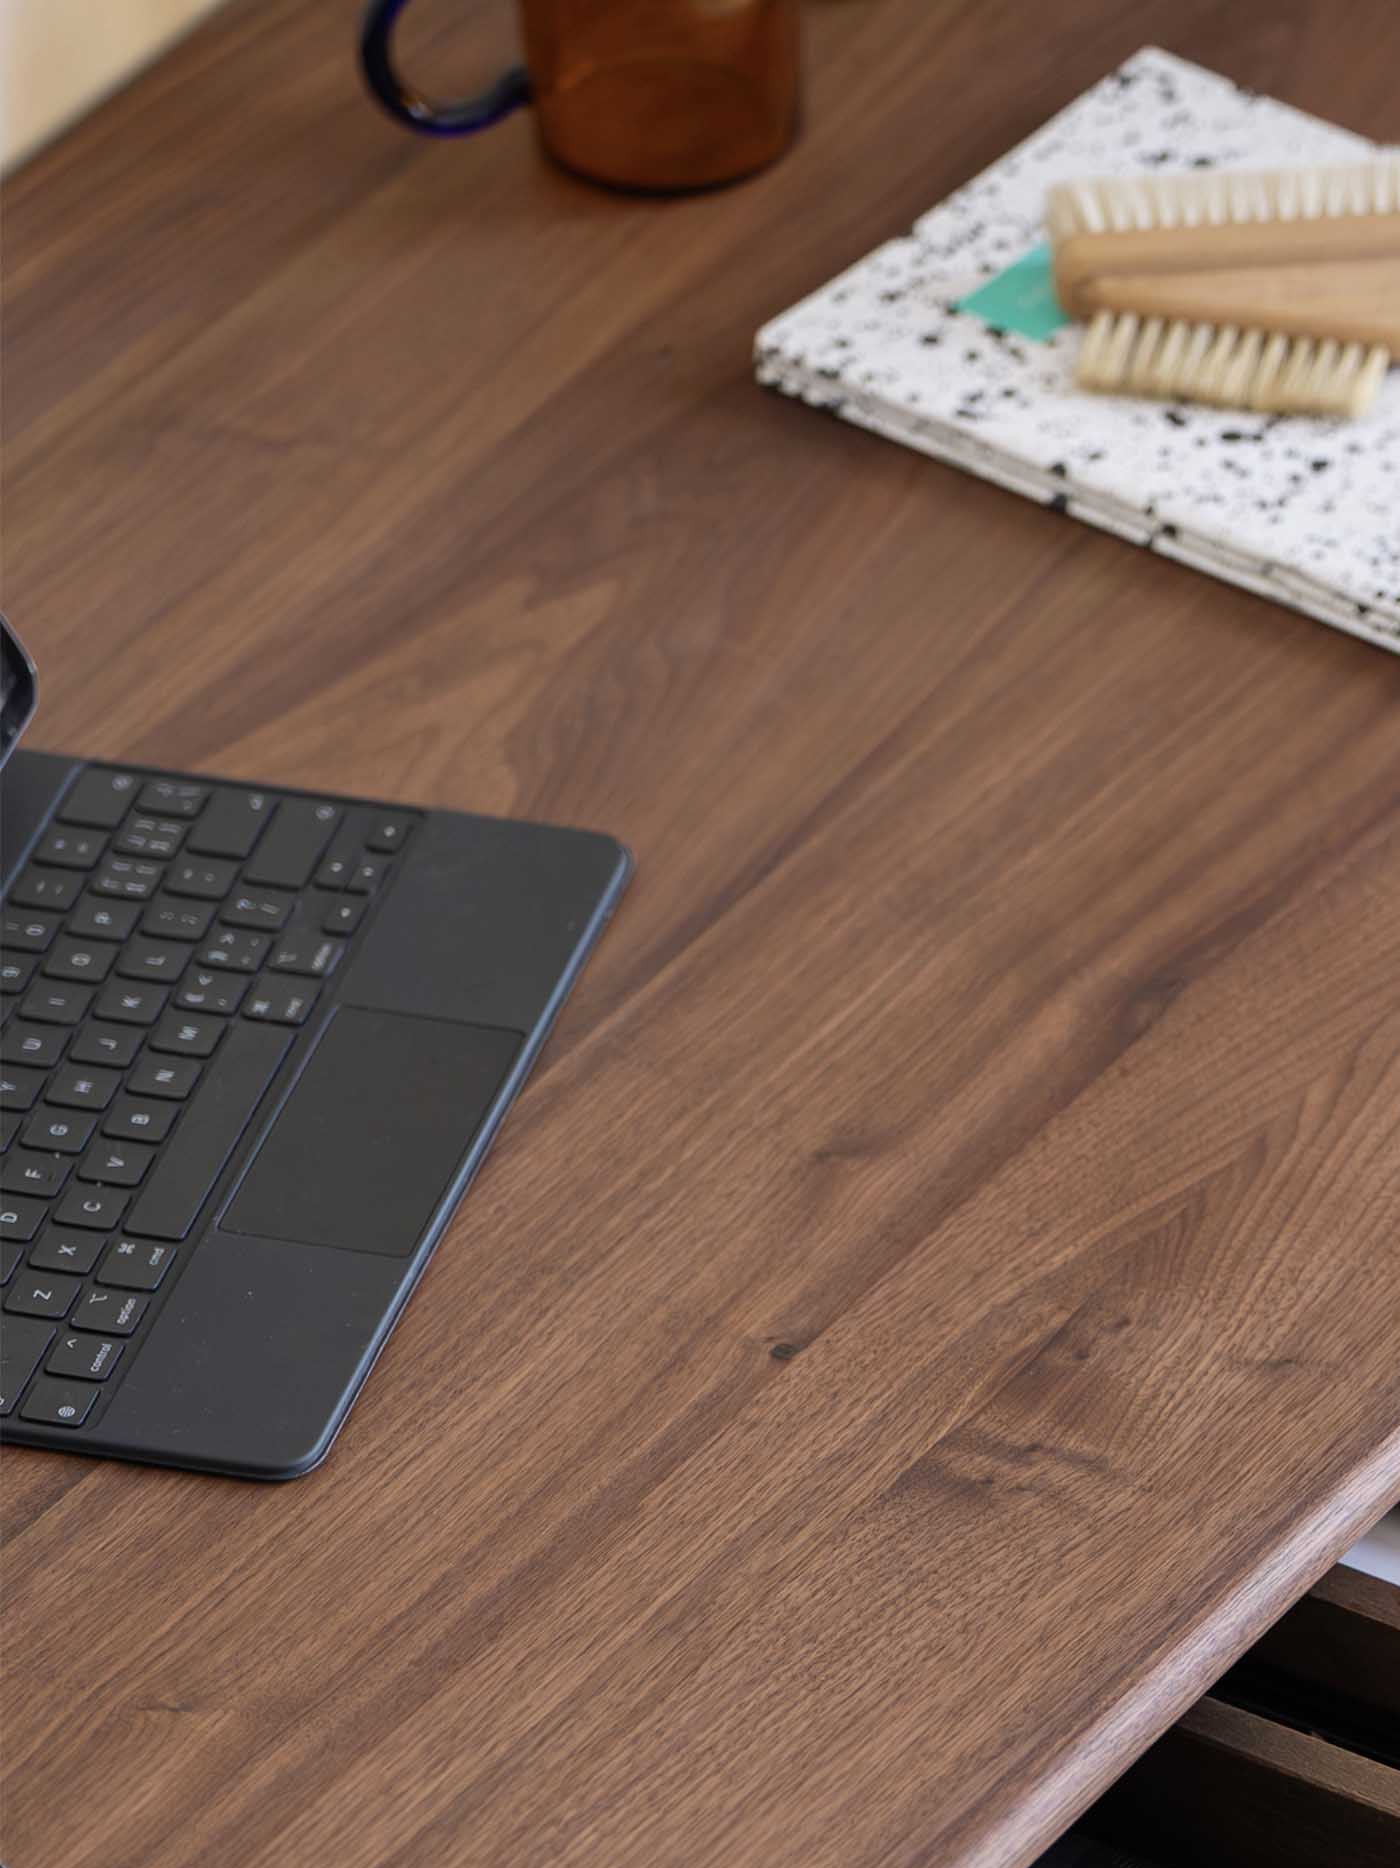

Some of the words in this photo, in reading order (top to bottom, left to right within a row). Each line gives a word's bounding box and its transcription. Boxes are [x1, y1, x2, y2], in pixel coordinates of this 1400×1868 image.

[155, 1069, 175, 1082] N
[107, 1155, 125, 1168] V
[25, 1168, 41, 1179] F
[83, 1201, 101, 1212] C
[58, 1244, 77, 1256] X
[33, 1289, 53, 1300] Z
[116, 1298, 137, 1325] option
[90, 1343, 112, 1373] control
